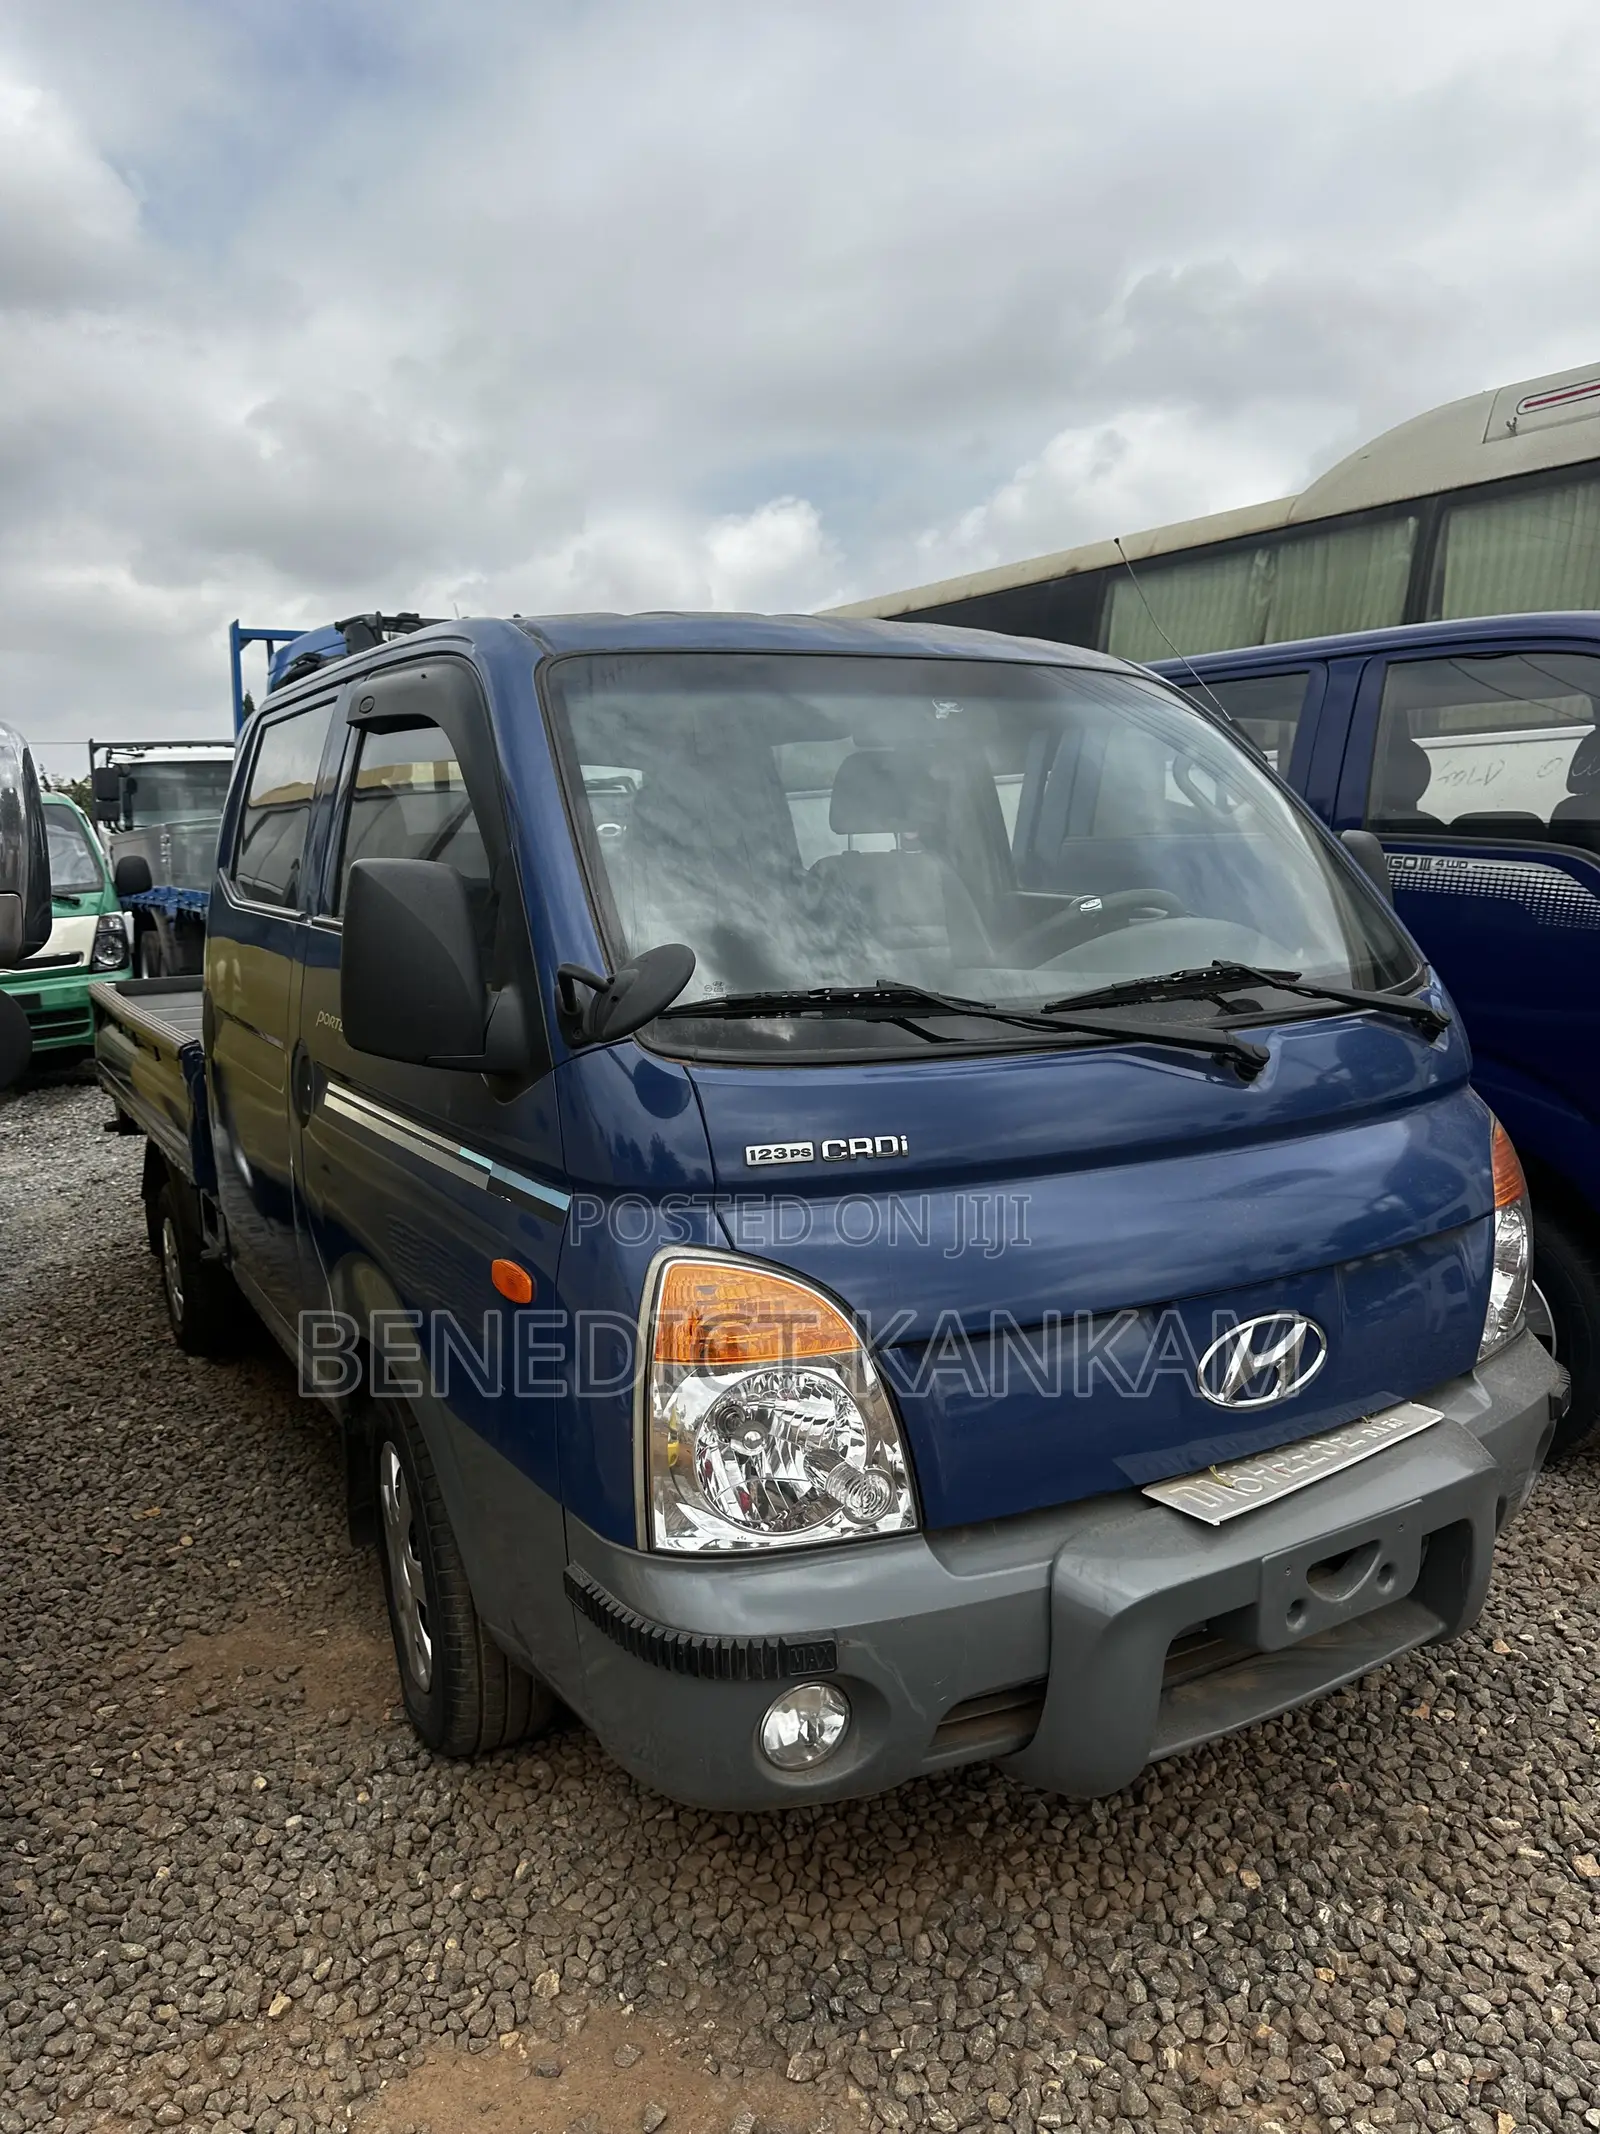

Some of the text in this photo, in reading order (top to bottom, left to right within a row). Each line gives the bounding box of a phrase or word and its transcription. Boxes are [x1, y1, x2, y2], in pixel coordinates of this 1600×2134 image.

[1386, 855, 1418, 871] GO
[1435, 860, 1469, 870] 4WD
[749, 1134, 909, 1162] 123PS CRDi
